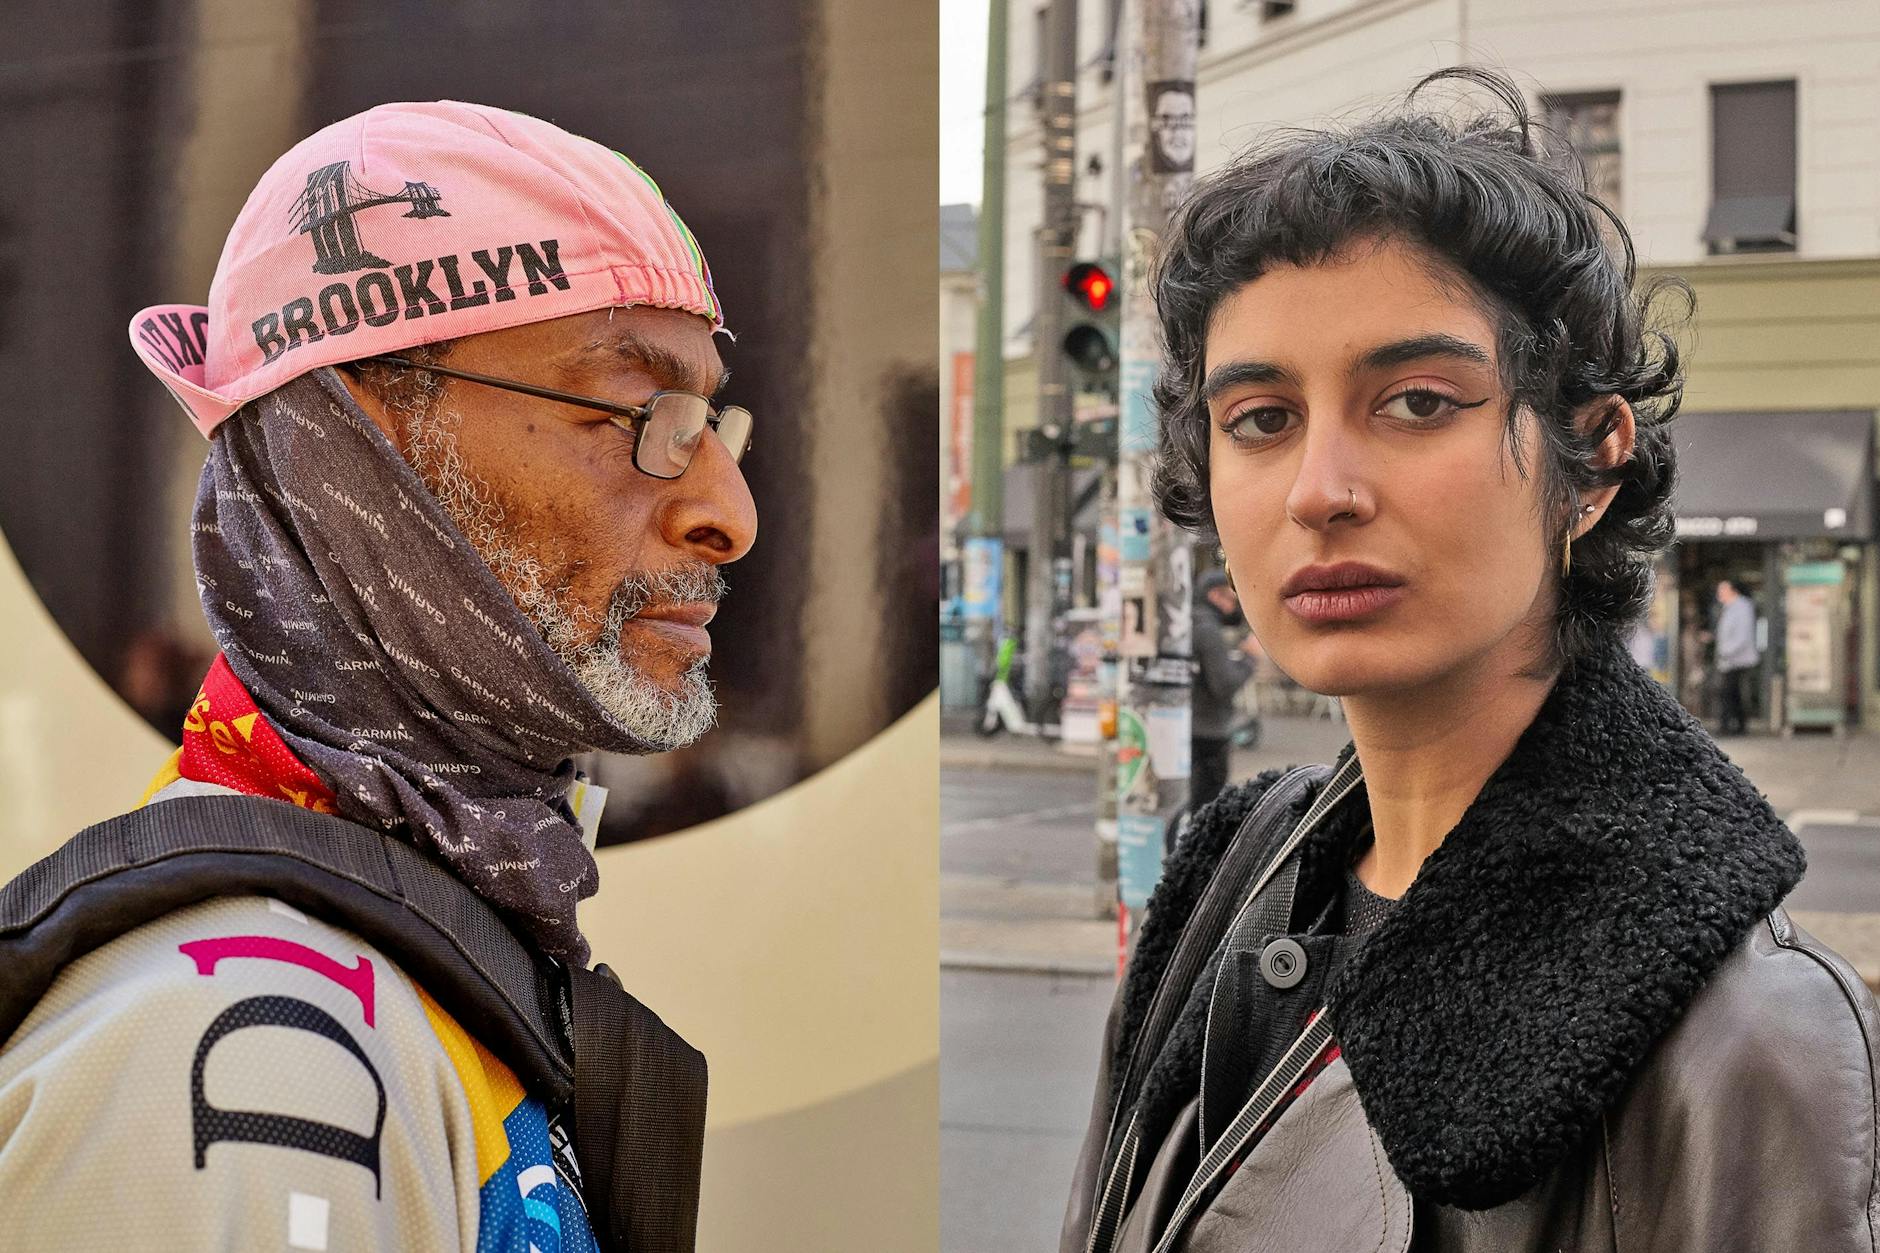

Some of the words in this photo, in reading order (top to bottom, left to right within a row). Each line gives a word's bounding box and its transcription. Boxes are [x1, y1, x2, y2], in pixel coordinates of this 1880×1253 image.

[252, 239, 572, 366] BROOKLYN
[275, 397, 325, 438] GARMIN
[323, 482, 384, 533] GARMIN
[399, 488, 455, 549] GARMIN
[387, 569, 446, 624] GARMIN
[464, 598, 524, 655] GARMIN
[451, 665, 510, 709] GARMIN
[526, 687, 584, 731] GARMIN
[351, 728, 408, 740] GARMIN
[490, 857, 541, 873] GARMIN
